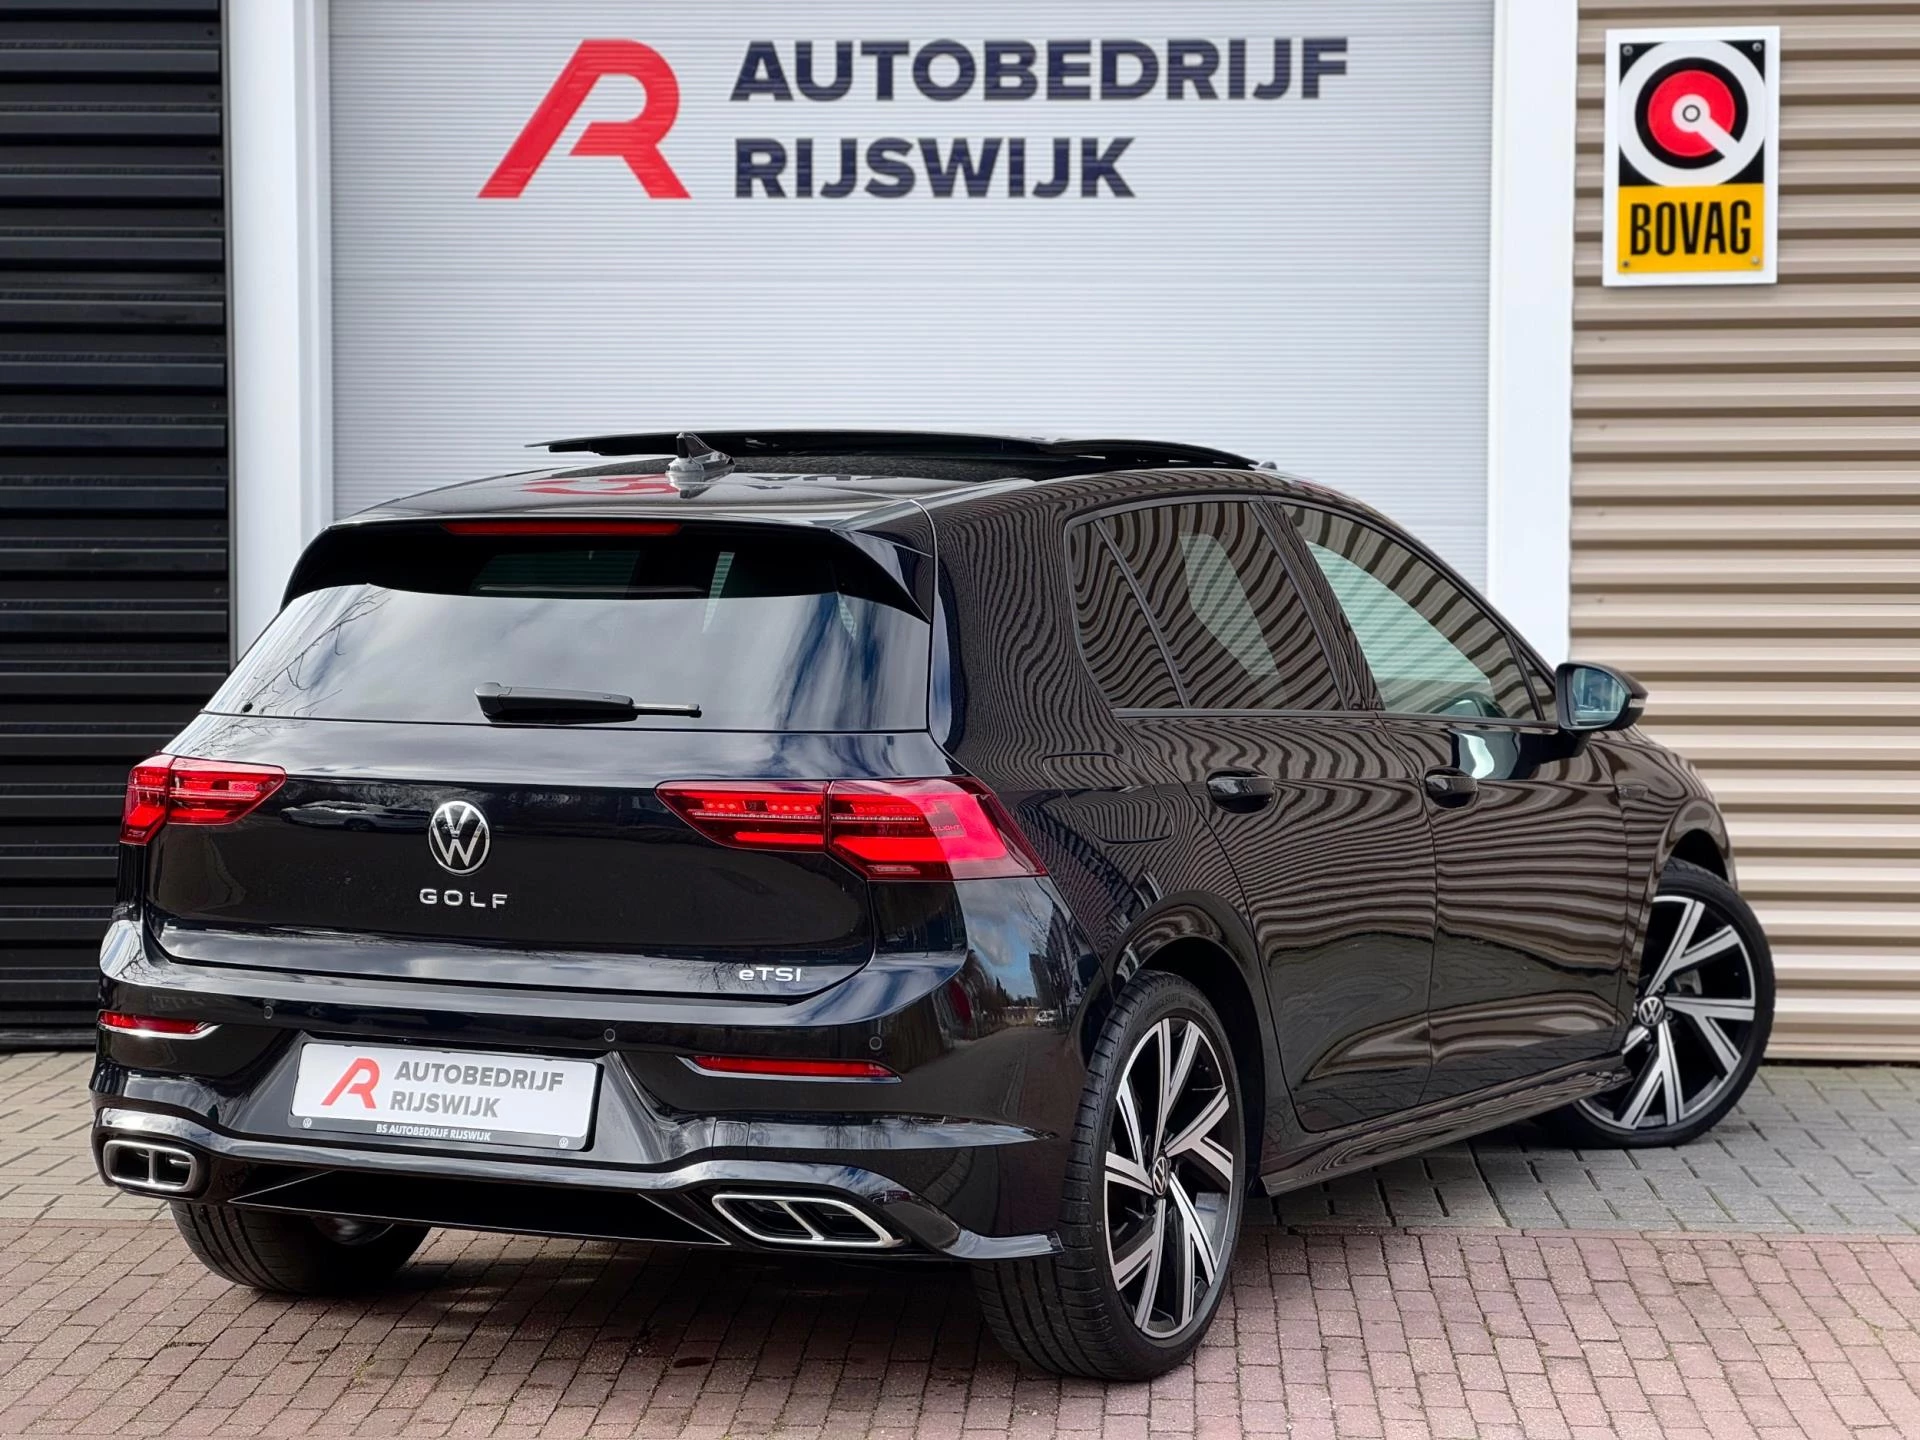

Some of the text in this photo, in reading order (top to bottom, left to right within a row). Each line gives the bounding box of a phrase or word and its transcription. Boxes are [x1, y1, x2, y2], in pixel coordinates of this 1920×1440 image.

[730, 38, 1348, 101] AUTOBEDRIJF
[735, 137, 1137, 199] RIJSWIJK
[1630, 200, 1751, 256] BOVAG
[429, 801, 490, 874] VW
[419, 888, 508, 909] GOLF
[738, 967, 802, 982] eTSI
[394, 1061, 564, 1091] AUTOBEDRIJF
[389, 1091, 500, 1118] RIJSWIJK
[376, 1123, 491, 1141] BS AUTOBEDRIJF RIJSWIJK
